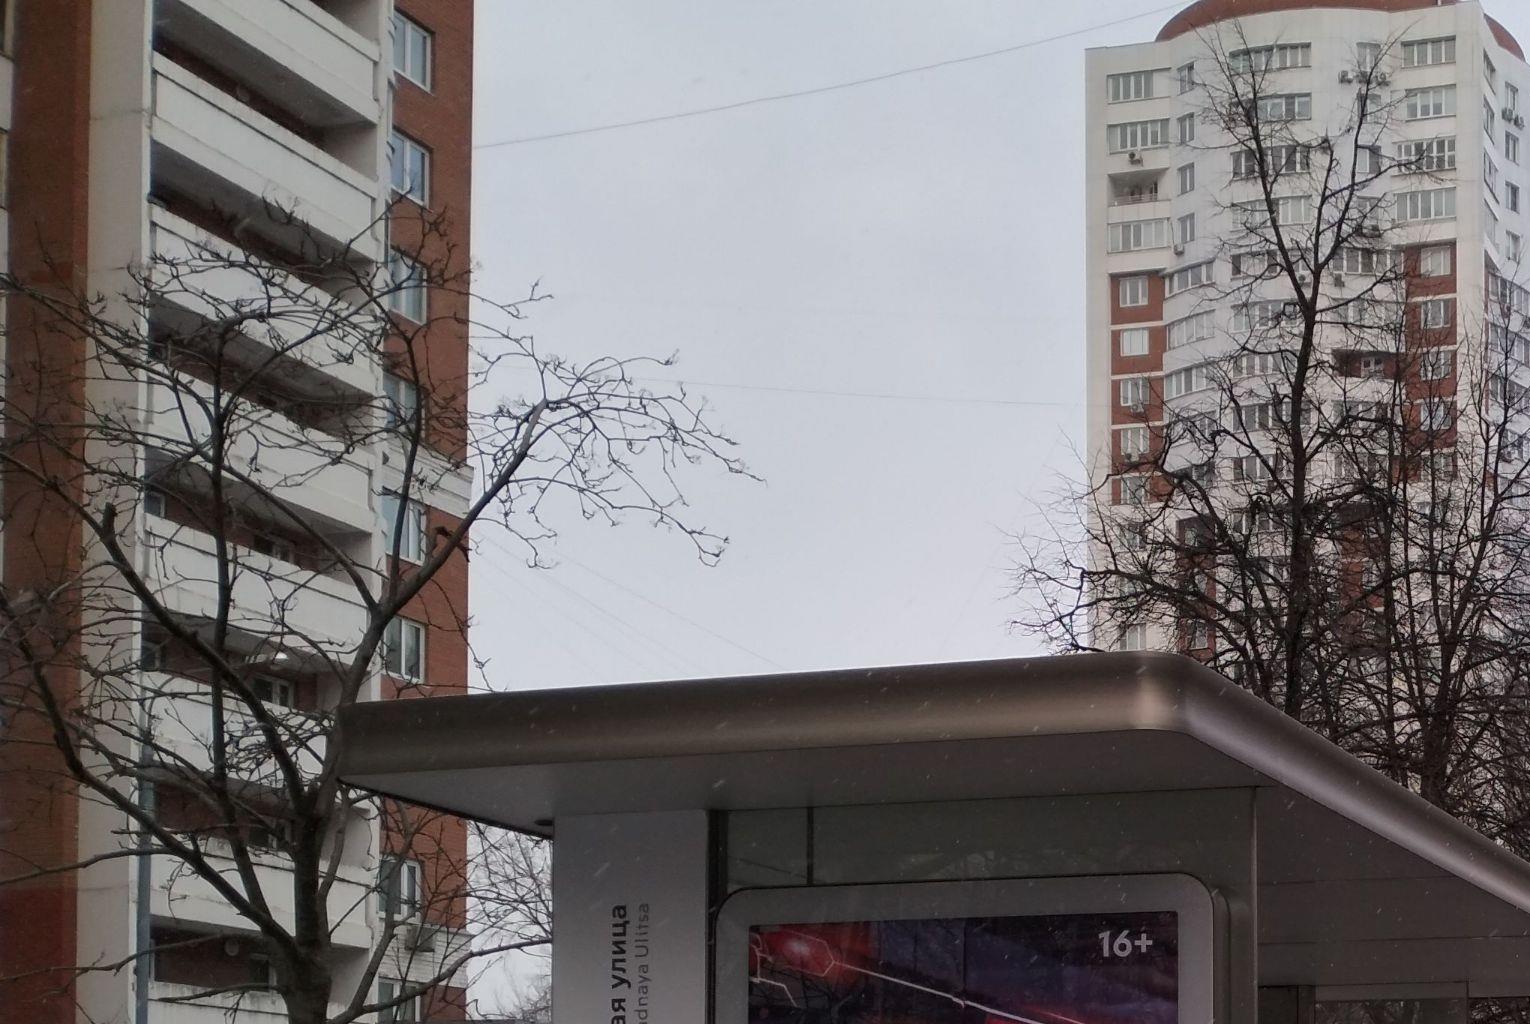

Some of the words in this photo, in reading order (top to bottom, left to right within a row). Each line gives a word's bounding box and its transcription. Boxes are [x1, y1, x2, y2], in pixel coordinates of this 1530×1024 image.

[611, 904, 631, 989] улица
[634, 903, 649, 958] Ulitsa
[1098, 929, 1154, 958] 16+
